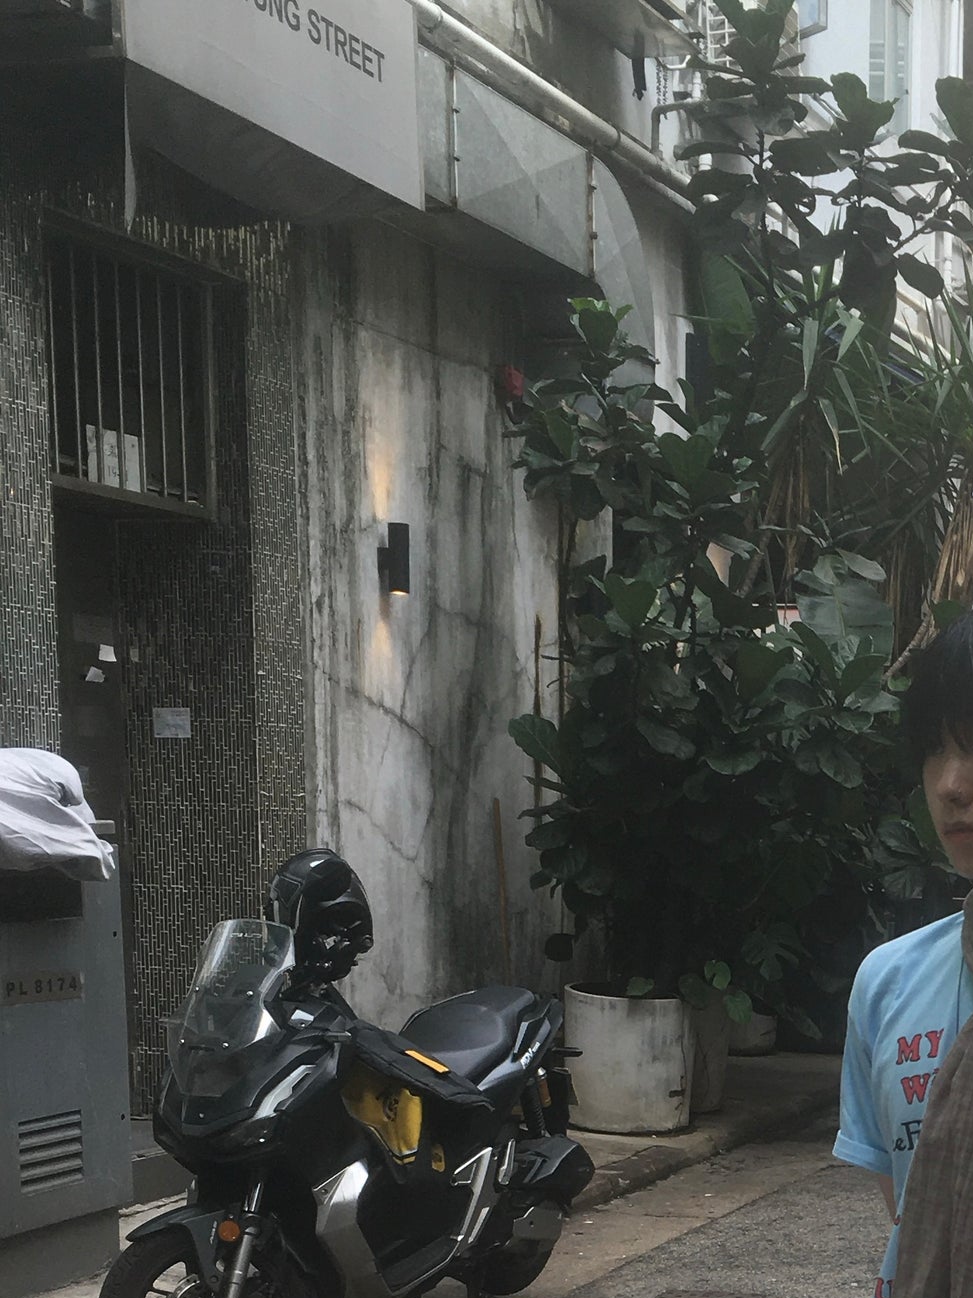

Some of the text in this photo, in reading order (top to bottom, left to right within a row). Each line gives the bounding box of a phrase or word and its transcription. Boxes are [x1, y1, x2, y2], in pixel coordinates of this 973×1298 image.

[307, 9, 385, 82] STREET
[6, 975, 77, 997] PL 8174
[896, 1028, 944, 1065] MY
